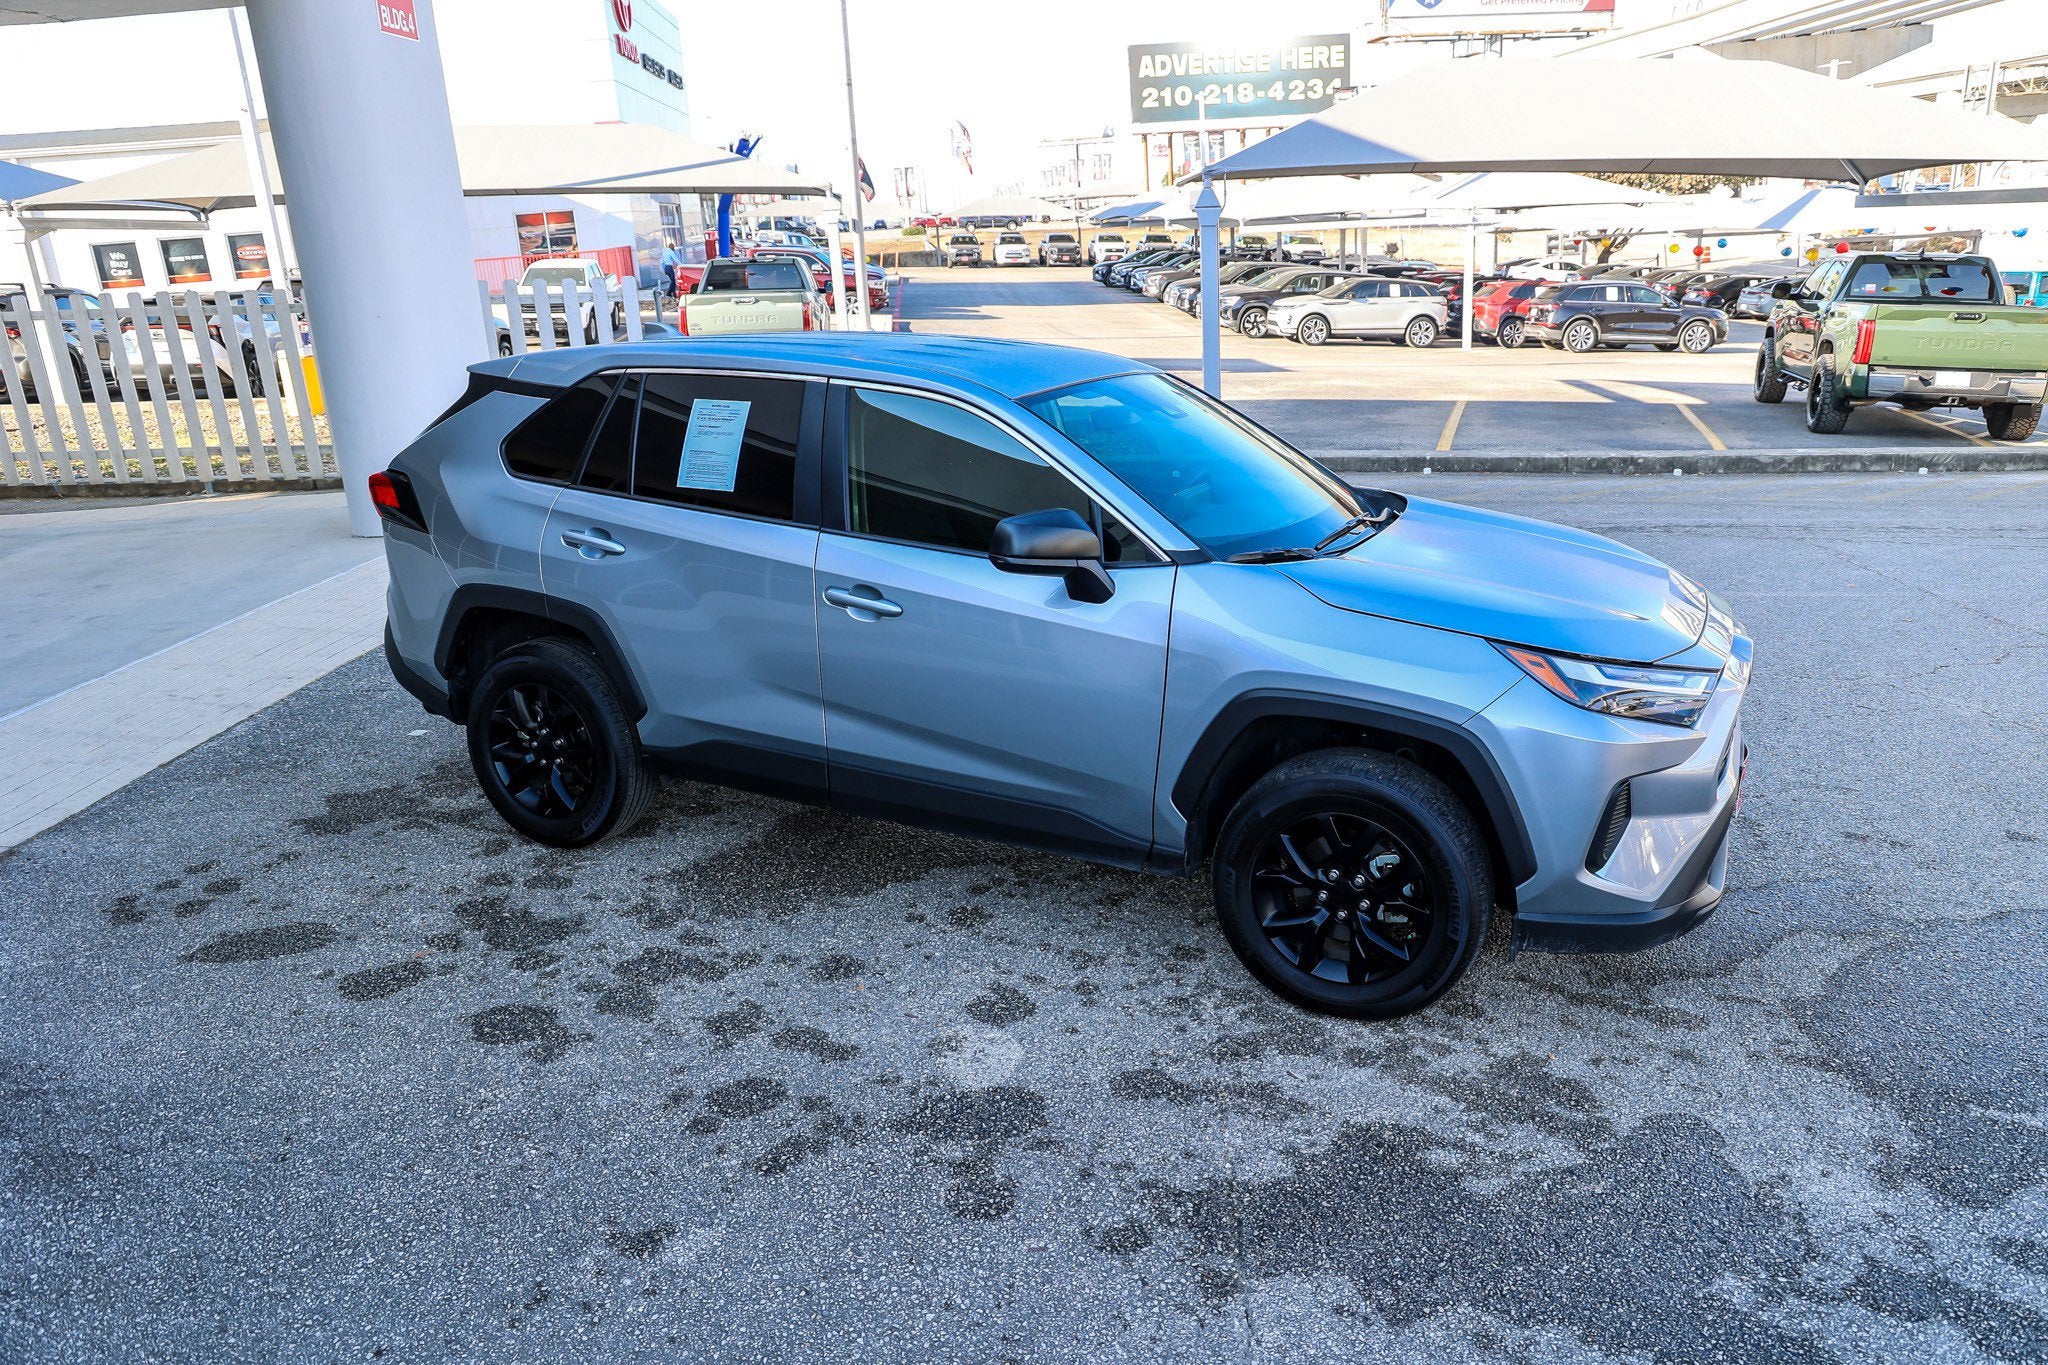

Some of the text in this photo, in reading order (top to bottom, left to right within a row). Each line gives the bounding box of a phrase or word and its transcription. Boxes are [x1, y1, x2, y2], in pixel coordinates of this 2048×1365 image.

[408, 12, 416, 35] 4
[1138, 44, 1345, 79] ADVERTISE HERE
[1141, 77, 1343, 109] 210-218-4234
[109, 252, 126, 261] We
[109, 260, 129, 269] Buy
[110, 268, 133, 277] Cars
[711, 314, 780, 325] TUNDRA
[1913, 336, 2016, 351] TUNDRA
[1442, 865, 1461, 942] MICHELIN
